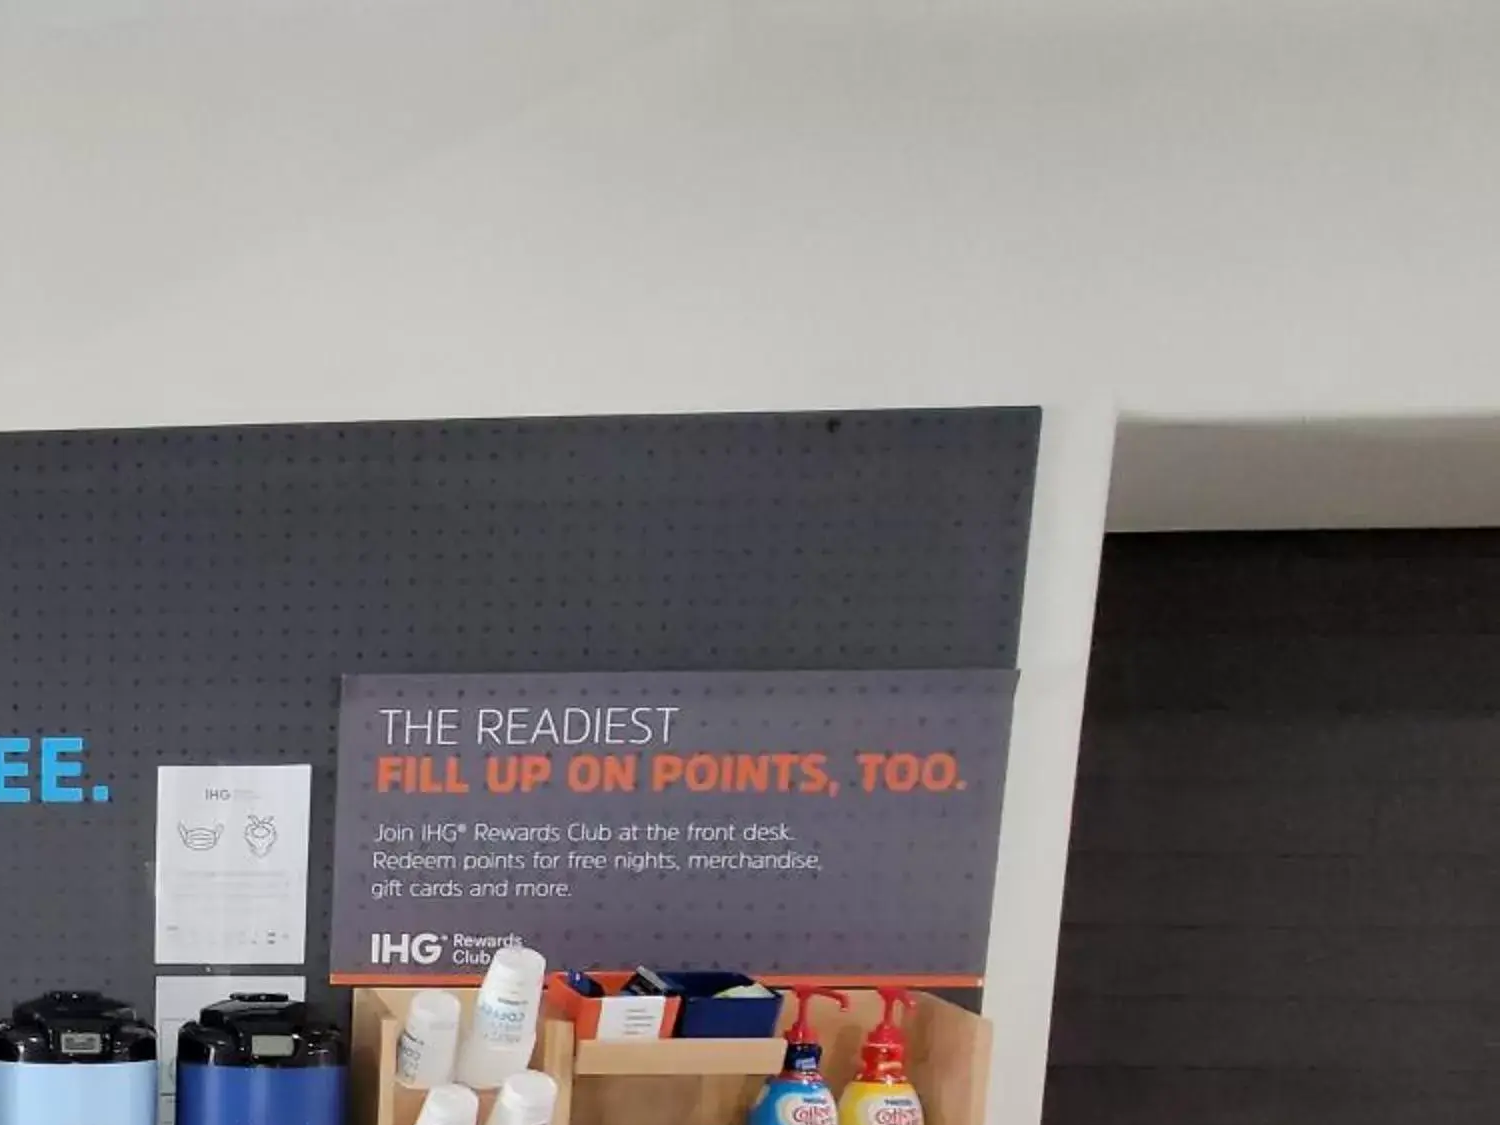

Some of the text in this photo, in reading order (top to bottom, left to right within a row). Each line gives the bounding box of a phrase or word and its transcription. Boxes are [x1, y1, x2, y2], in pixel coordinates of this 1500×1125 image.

[378, 706, 680, 745] THE READIEST
[376, 752, 968, 798] FILL UP ON POINTS, TOO.
[374, 823, 414, 843] Join
[473, 822, 561, 842] Rewards
[567, 822, 613, 842] Club
[618, 824, 638, 842] at
[646, 823, 681, 842] the
[687, 822, 737, 842] front
[372, 850, 824, 873] Redeem points for free nights, merchandise,
[371, 879, 573, 900] gift cards and more.
[452, 932, 524, 949] Rewards
[452, 949, 492, 966] Club
